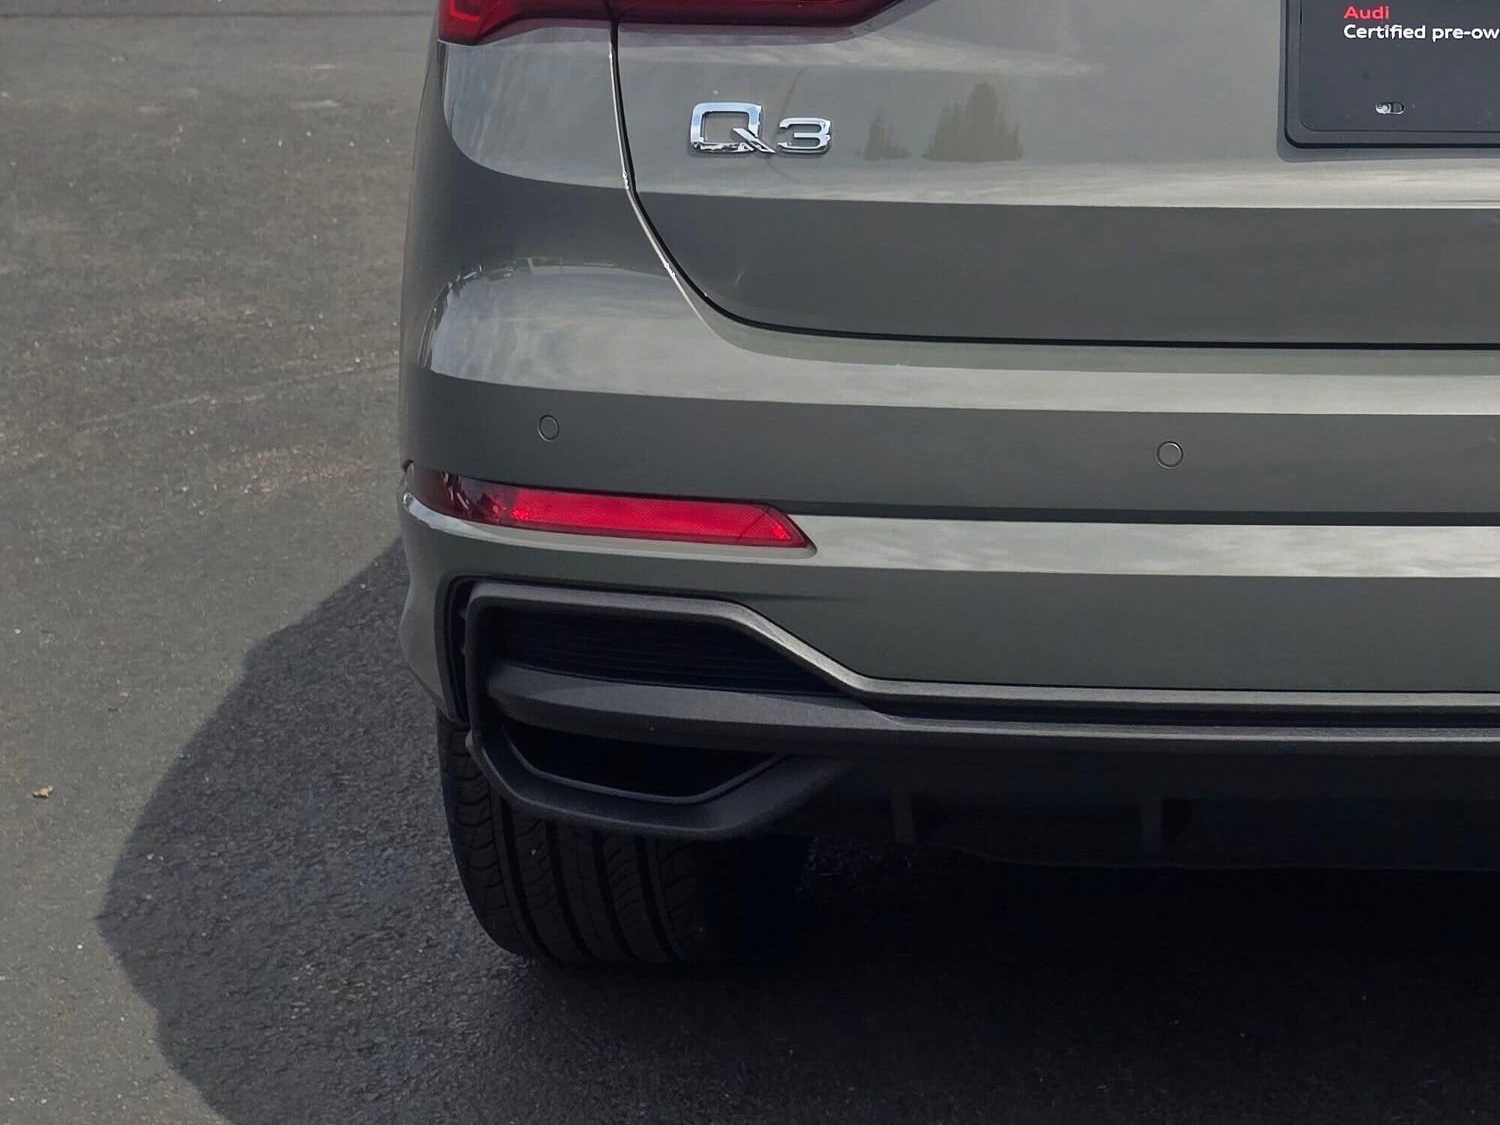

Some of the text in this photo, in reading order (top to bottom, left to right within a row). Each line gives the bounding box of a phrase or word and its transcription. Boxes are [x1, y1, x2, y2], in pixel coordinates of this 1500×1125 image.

[1343, 5, 1390, 20] Audi
[1343, 23, 1426, 40] Certified
[690, 102, 831, 155] Q3
